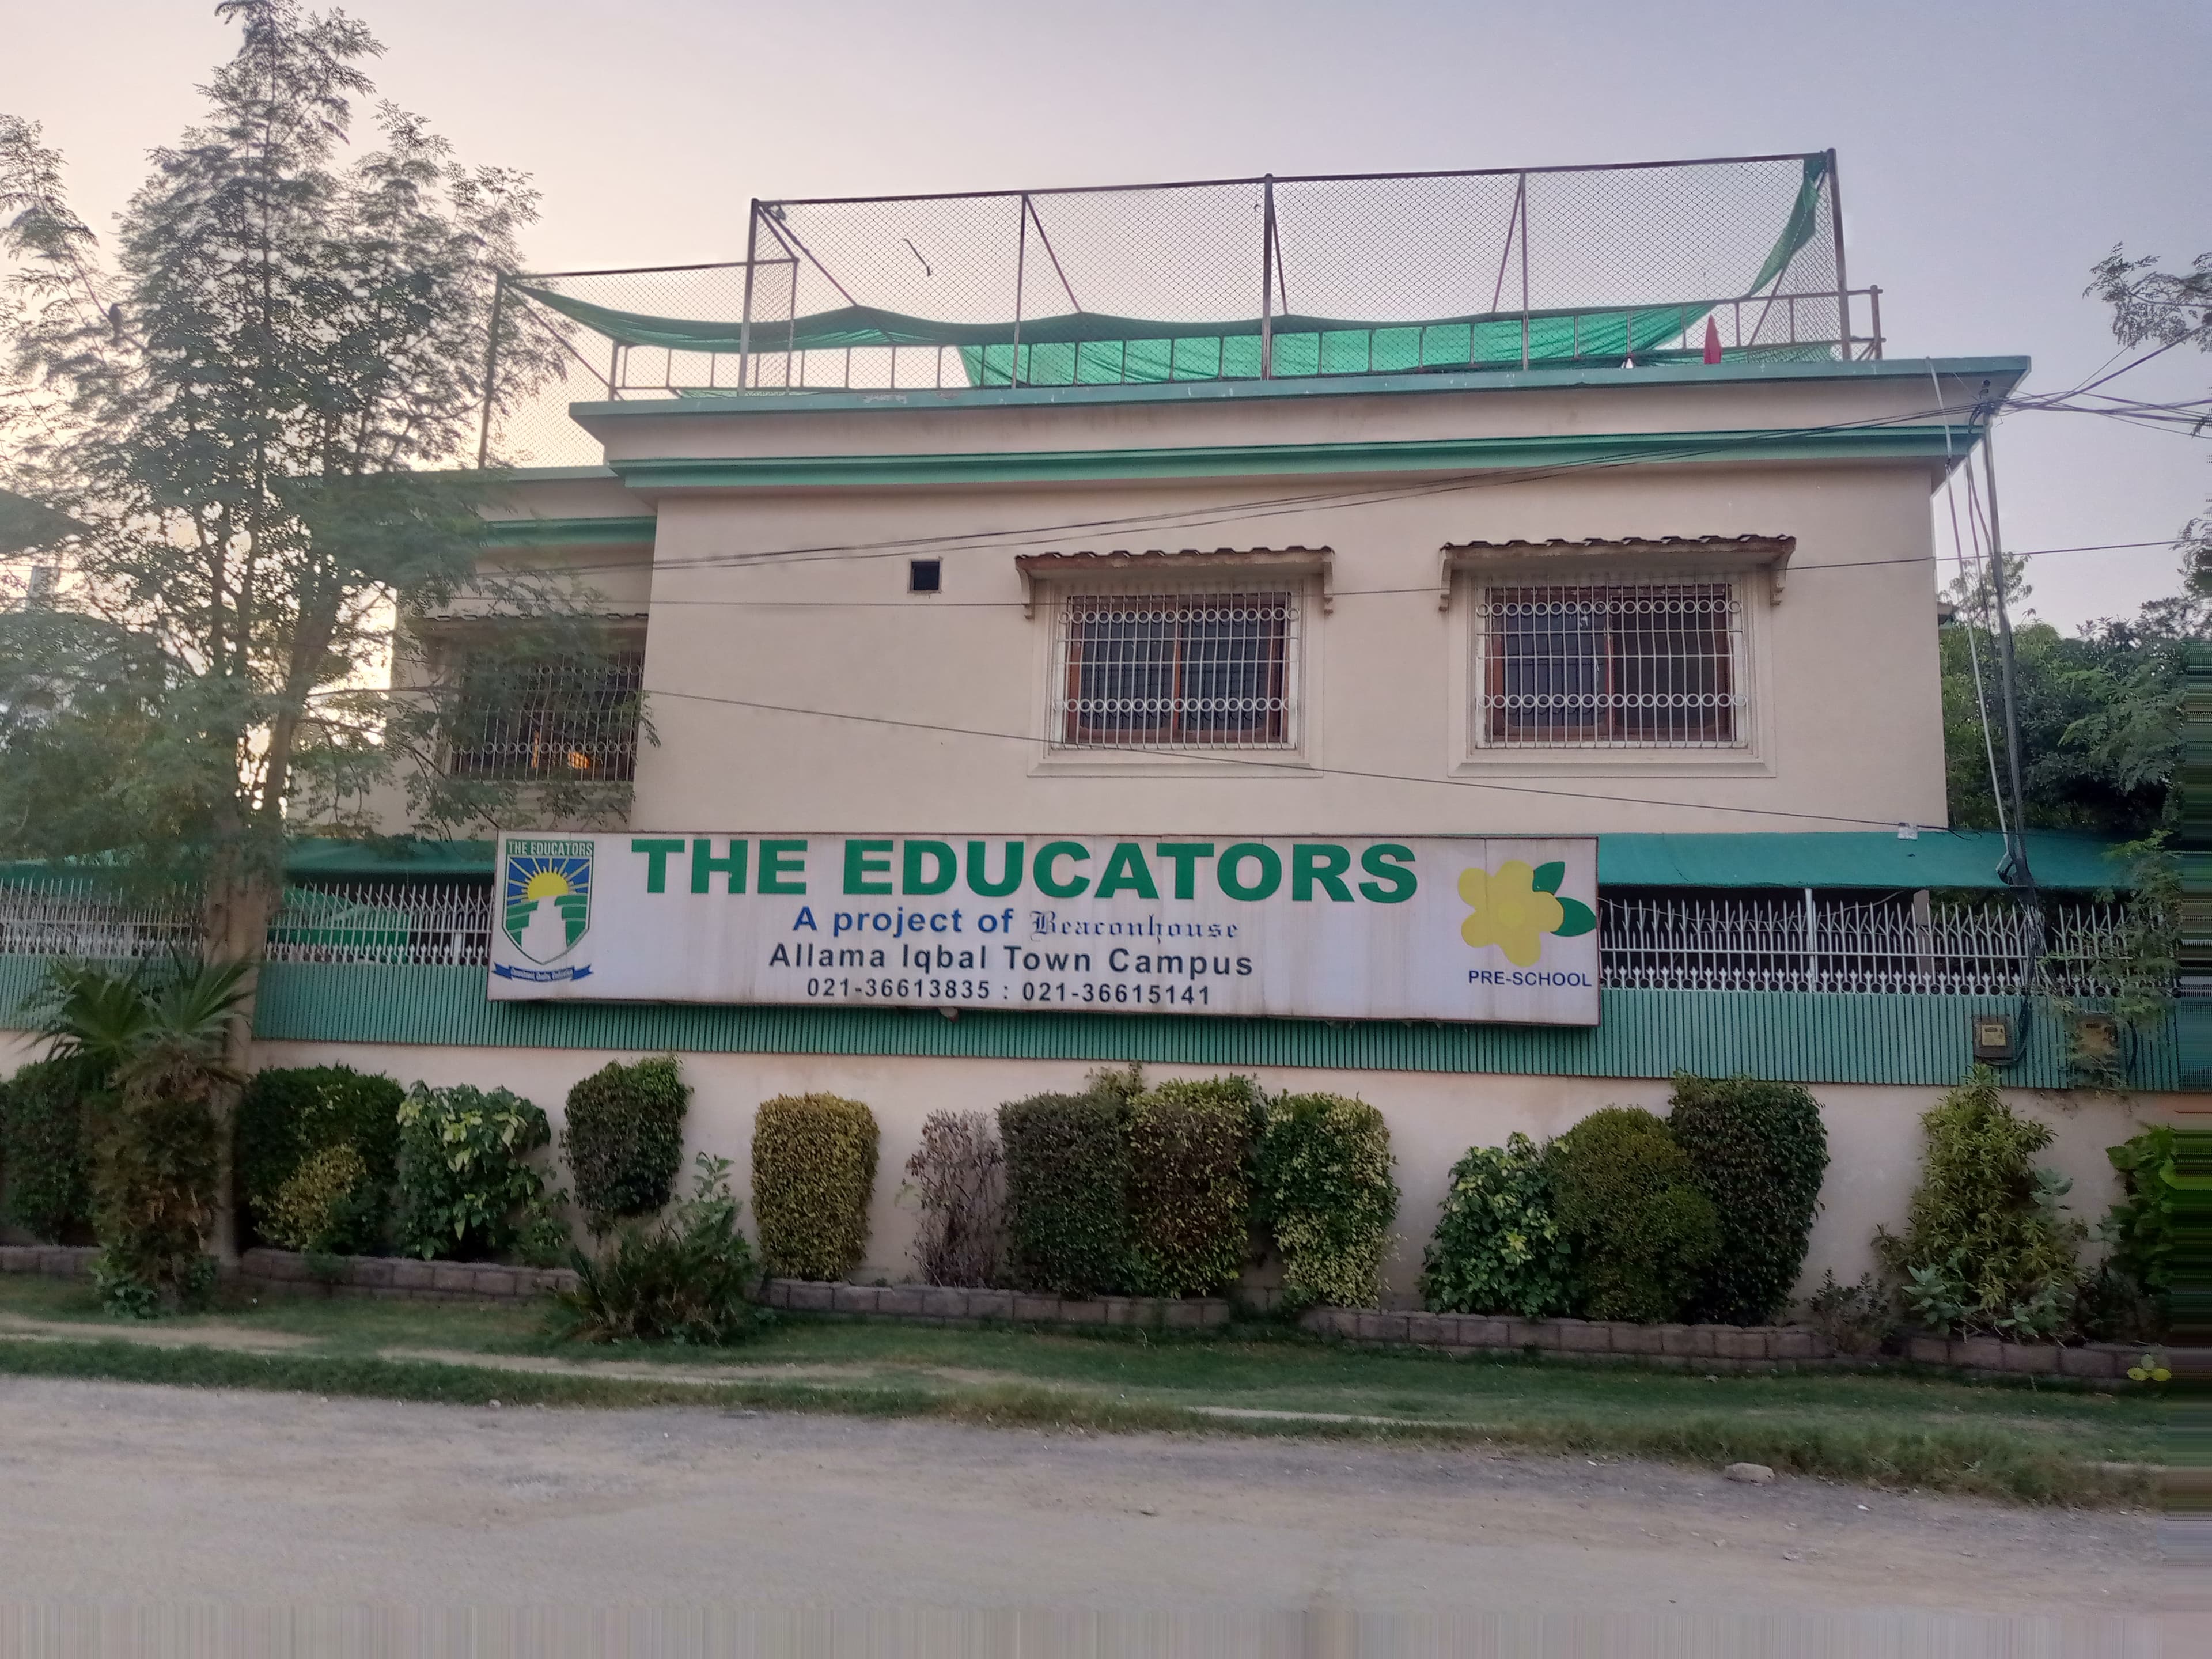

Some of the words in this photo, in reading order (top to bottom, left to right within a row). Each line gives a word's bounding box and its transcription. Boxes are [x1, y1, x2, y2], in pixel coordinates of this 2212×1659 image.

[508, 840, 527, 855] THE
[531, 841, 593, 856] EDUCATORS
[631, 839, 808, 895] THE
[843, 839, 1418, 904] EDUCATORS
[792, 906, 818, 932] A
[833, 907, 963, 938] project
[977, 908, 1014, 933] of
[1029, 910, 1239, 944] Beaconhouse
[769, 942, 886, 968] Allama
[903, 944, 986, 974] Iqbal
[1003, 945, 1091, 972] Town
[1108, 948, 1253, 980] Campus
[807, 978, 990, 1000] 021-36613835
[1022, 982, 1209, 1005] 021-36615141
[1468, 970, 1592, 987] PRE-SCHOOL
